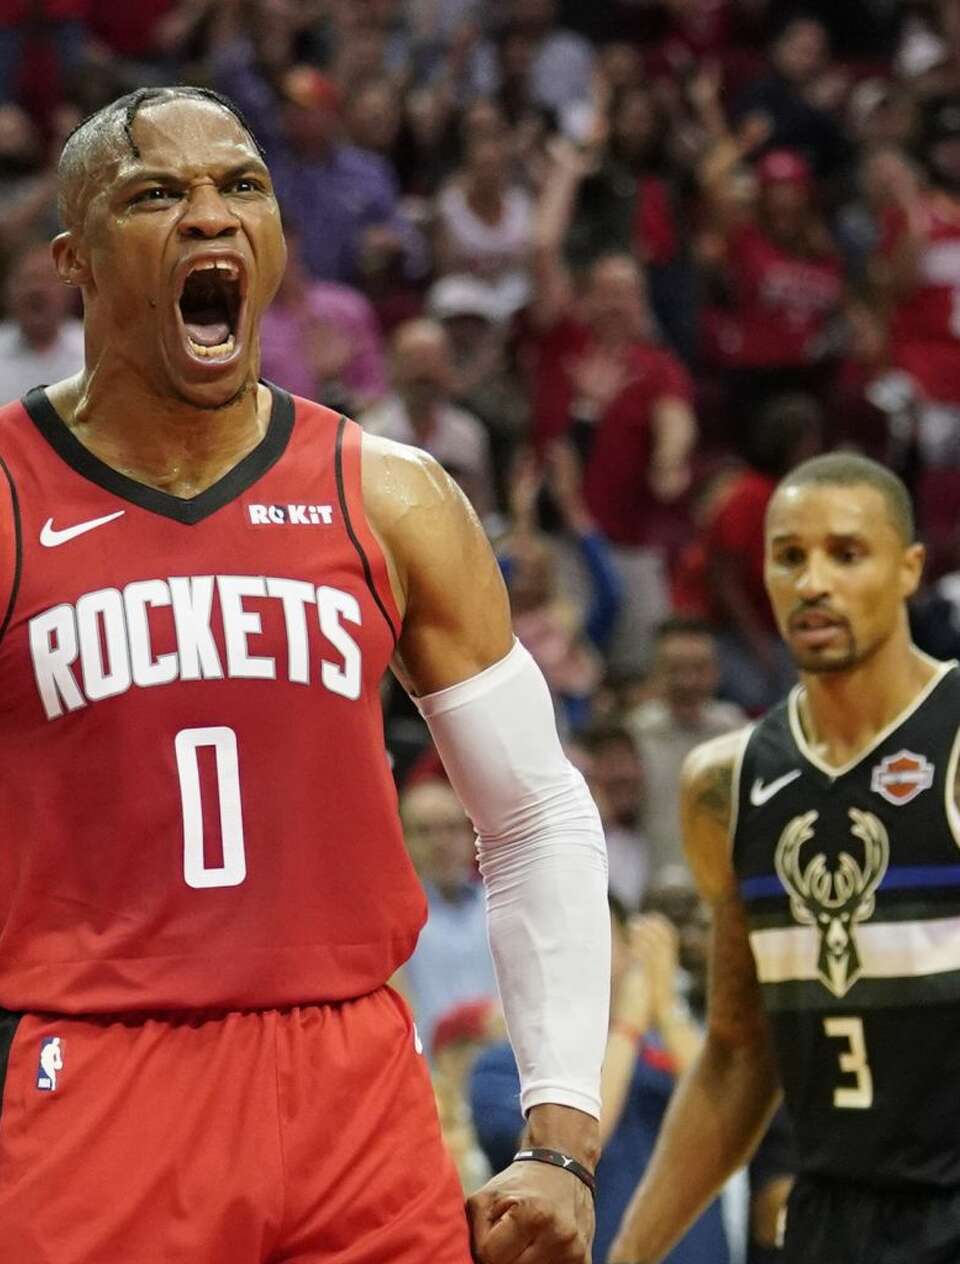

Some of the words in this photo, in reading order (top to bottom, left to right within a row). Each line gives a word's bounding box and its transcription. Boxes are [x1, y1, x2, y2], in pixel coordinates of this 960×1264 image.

[28, 575, 362, 721] ROCKETS
[174, 726, 247, 889] 0
[822, 1016, 873, 1109] 3
